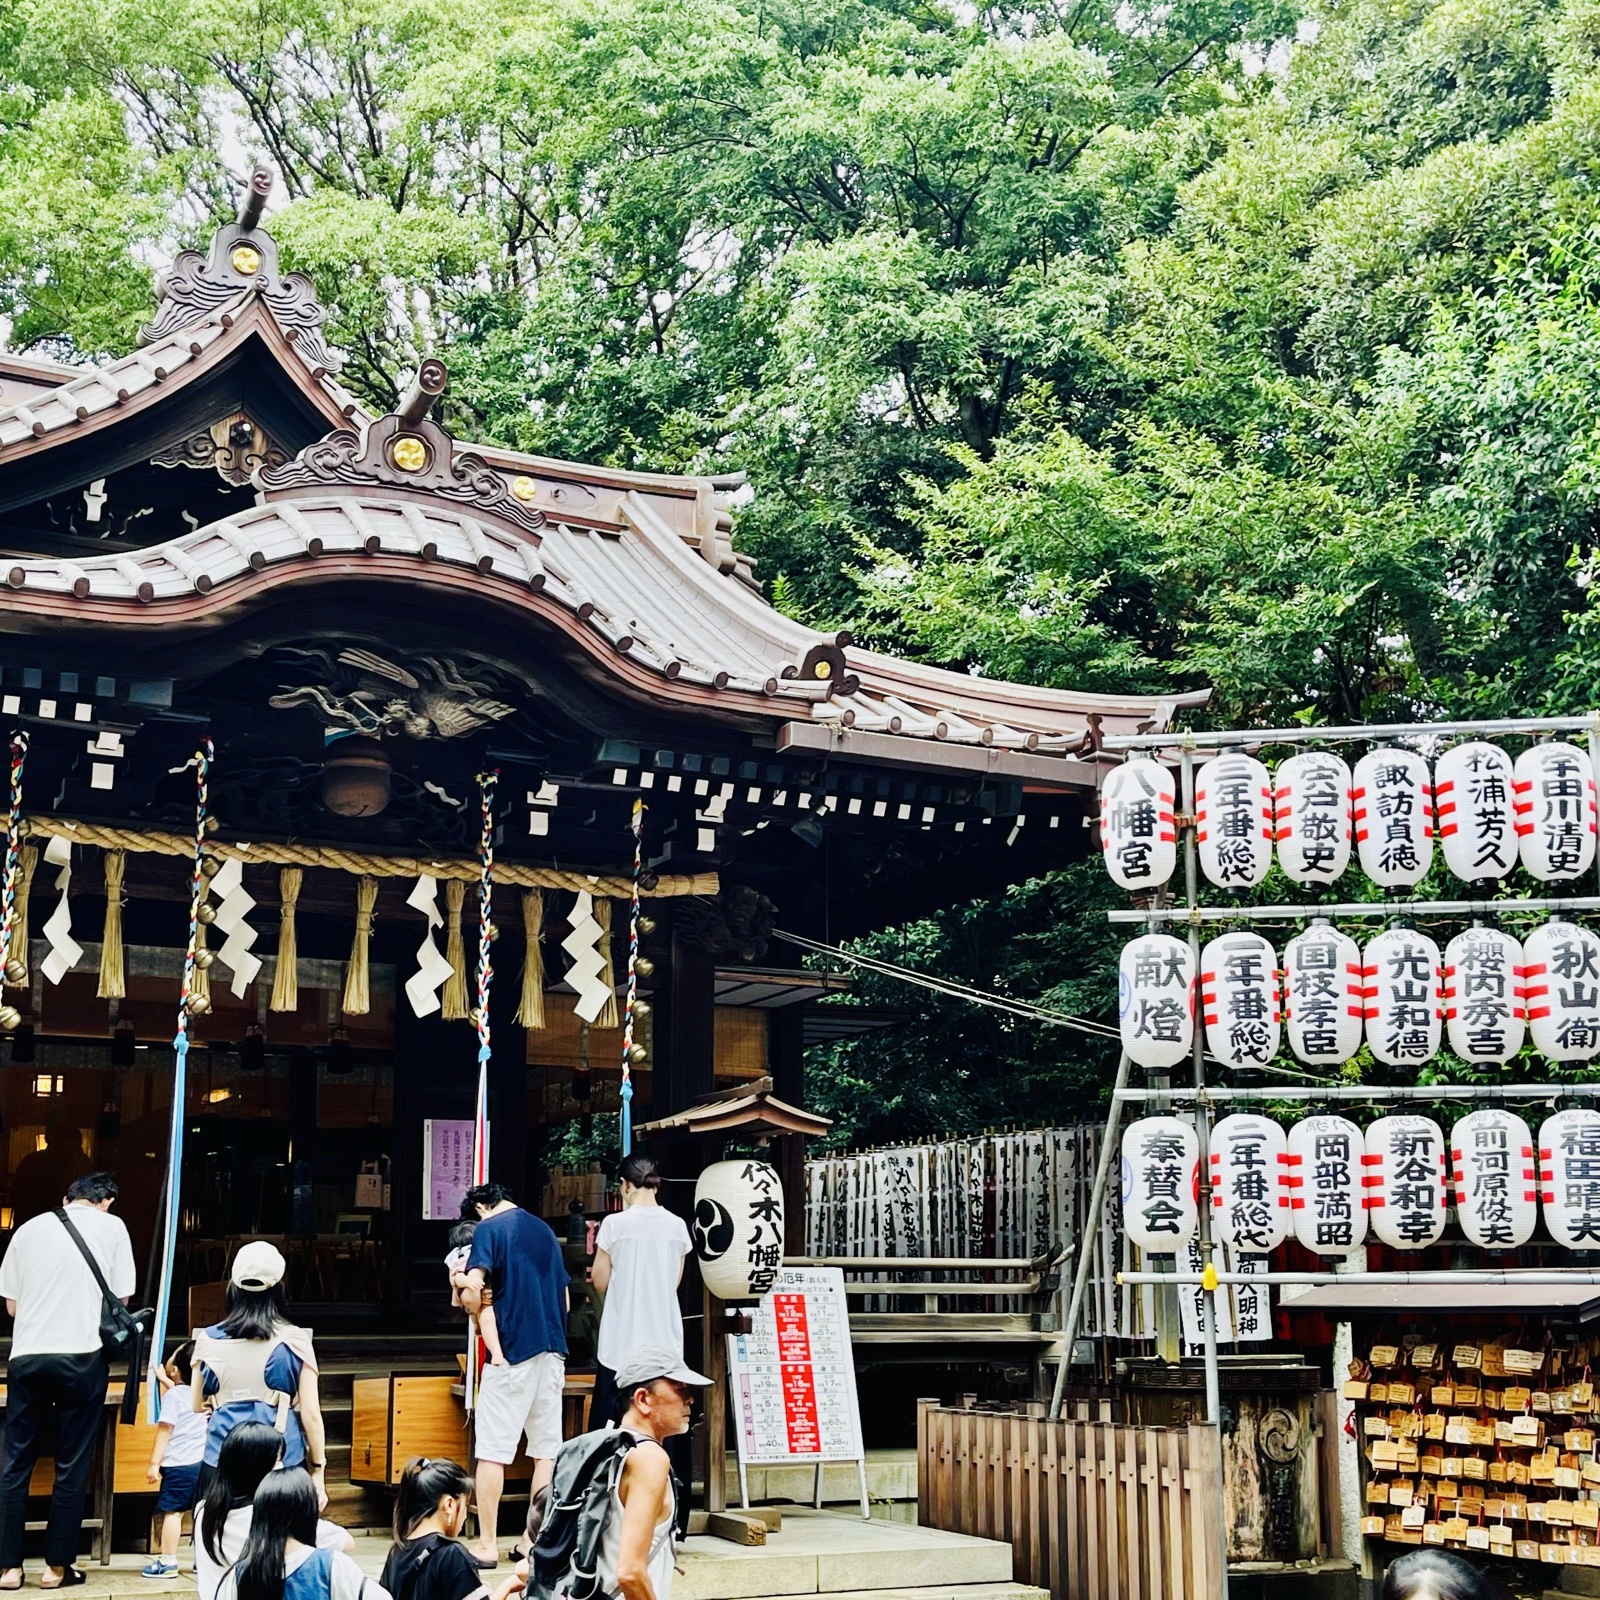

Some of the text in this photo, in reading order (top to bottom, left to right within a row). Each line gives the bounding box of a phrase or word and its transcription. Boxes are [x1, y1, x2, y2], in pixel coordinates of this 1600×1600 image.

[1111, 768, 1157, 879] 八幡宮
[1214, 759, 1255, 882] 三年番総代
[1297, 766, 1341, 873] 宍戸敬史
[1373, 763, 1420, 873] 諏訪貞徳
[1465, 749, 1507, 869] 松浦芳久
[1541, 752, 1584, 874] 宇田川清史
[1134, 945, 1187, 1043] 献燈
[1222, 940, 1271, 1064] 一年番総代
[1293, 941, 1340, 1056] 国枝孝臣
[1458, 942, 1510, 1055] 櫻内秀吉
[1551, 940, 1600, 1050] 秋山衛
[741, 1162, 782, 1294] 代々木八幡宮
[1141, 1128, 1186, 1235] 奉賛会
[1228, 1123, 1274, 1248] 二年番総代
[1312, 1134, 1353, 1246] 岡部満昭
[1389, 1128, 1437, 1244] 新谷和幸
[1471, 1120, 1516, 1245] 前河原俊夫
[1560, 1124, 1600, 1243] 福田晴夫
[1237, 1250, 1257, 1334] 荷大明神
